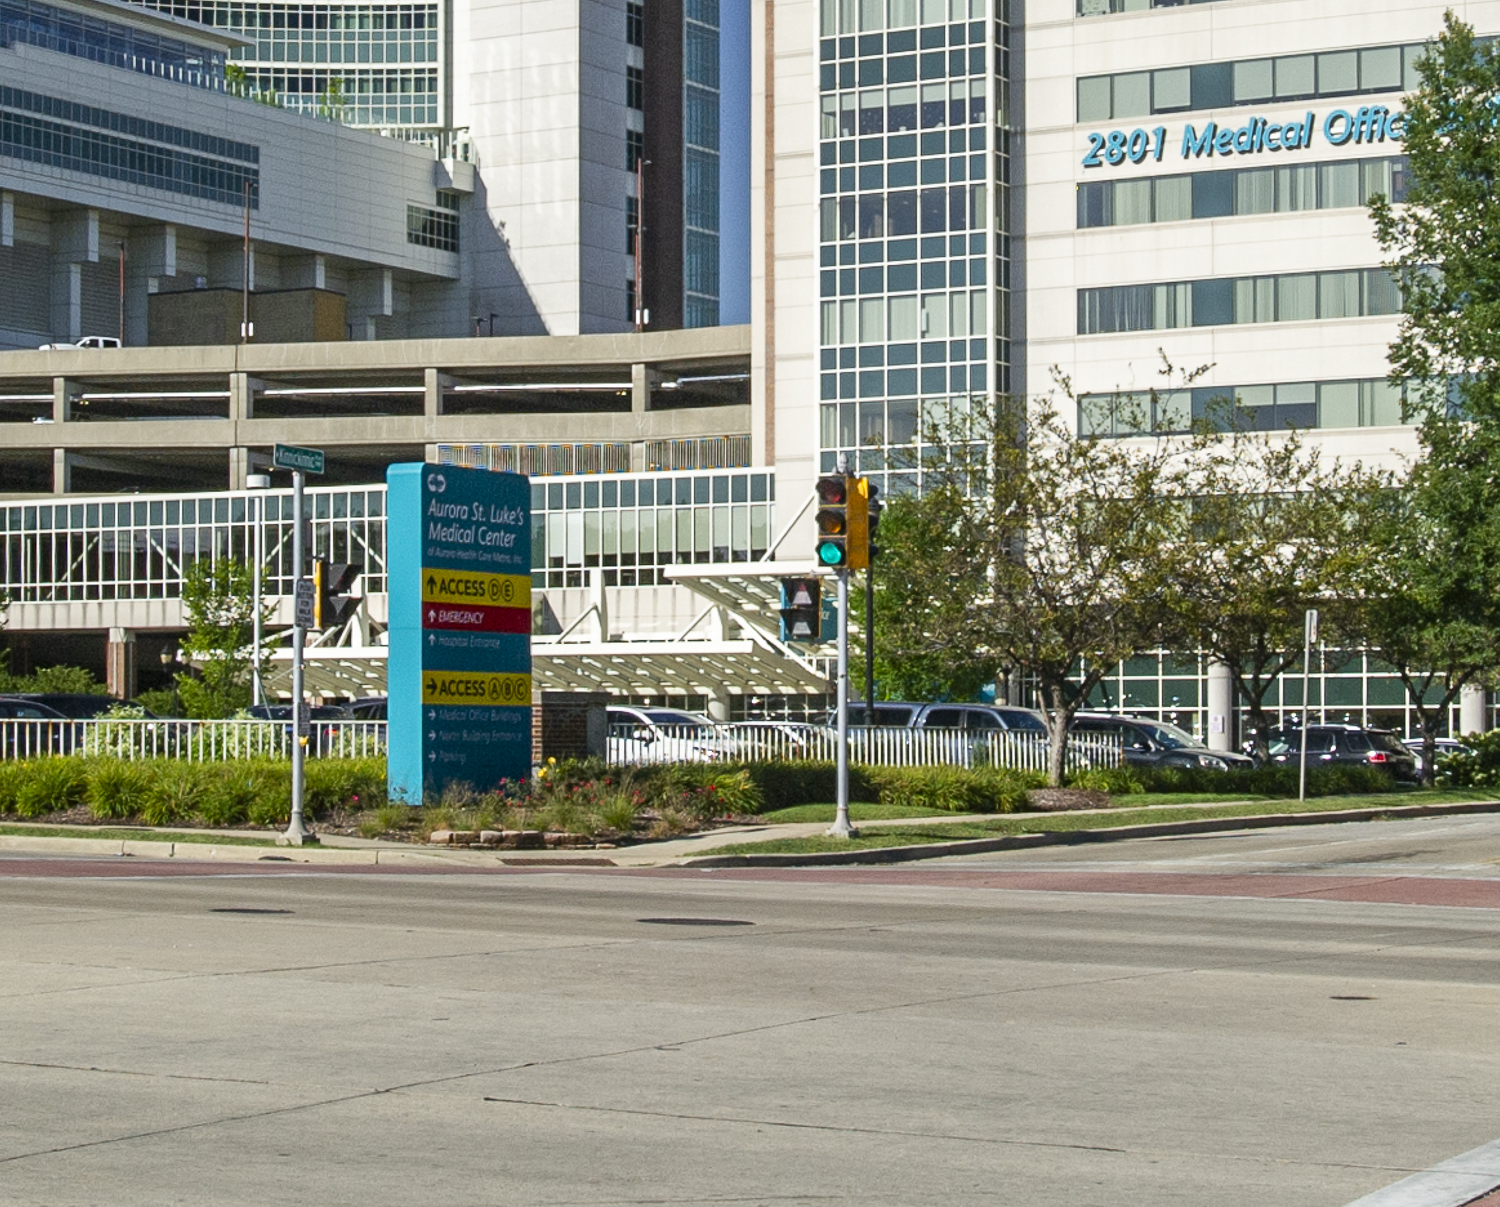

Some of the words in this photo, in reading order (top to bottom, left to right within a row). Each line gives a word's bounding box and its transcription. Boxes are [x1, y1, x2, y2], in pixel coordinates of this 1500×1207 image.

[1080, 126, 1165, 166] 2801
[1181, 111, 1314, 159] Medical
[428, 497, 469, 520] Aurora
[471, 501, 486, 522] St.
[490, 503, 524, 526] Luke's
[428, 521, 475, 544] Medical
[478, 526, 517, 548] Center
[439, 578, 486, 597] ACCESS
[438, 609, 484, 624] EMERGENCY
[439, 679, 486, 697] ACCESS
